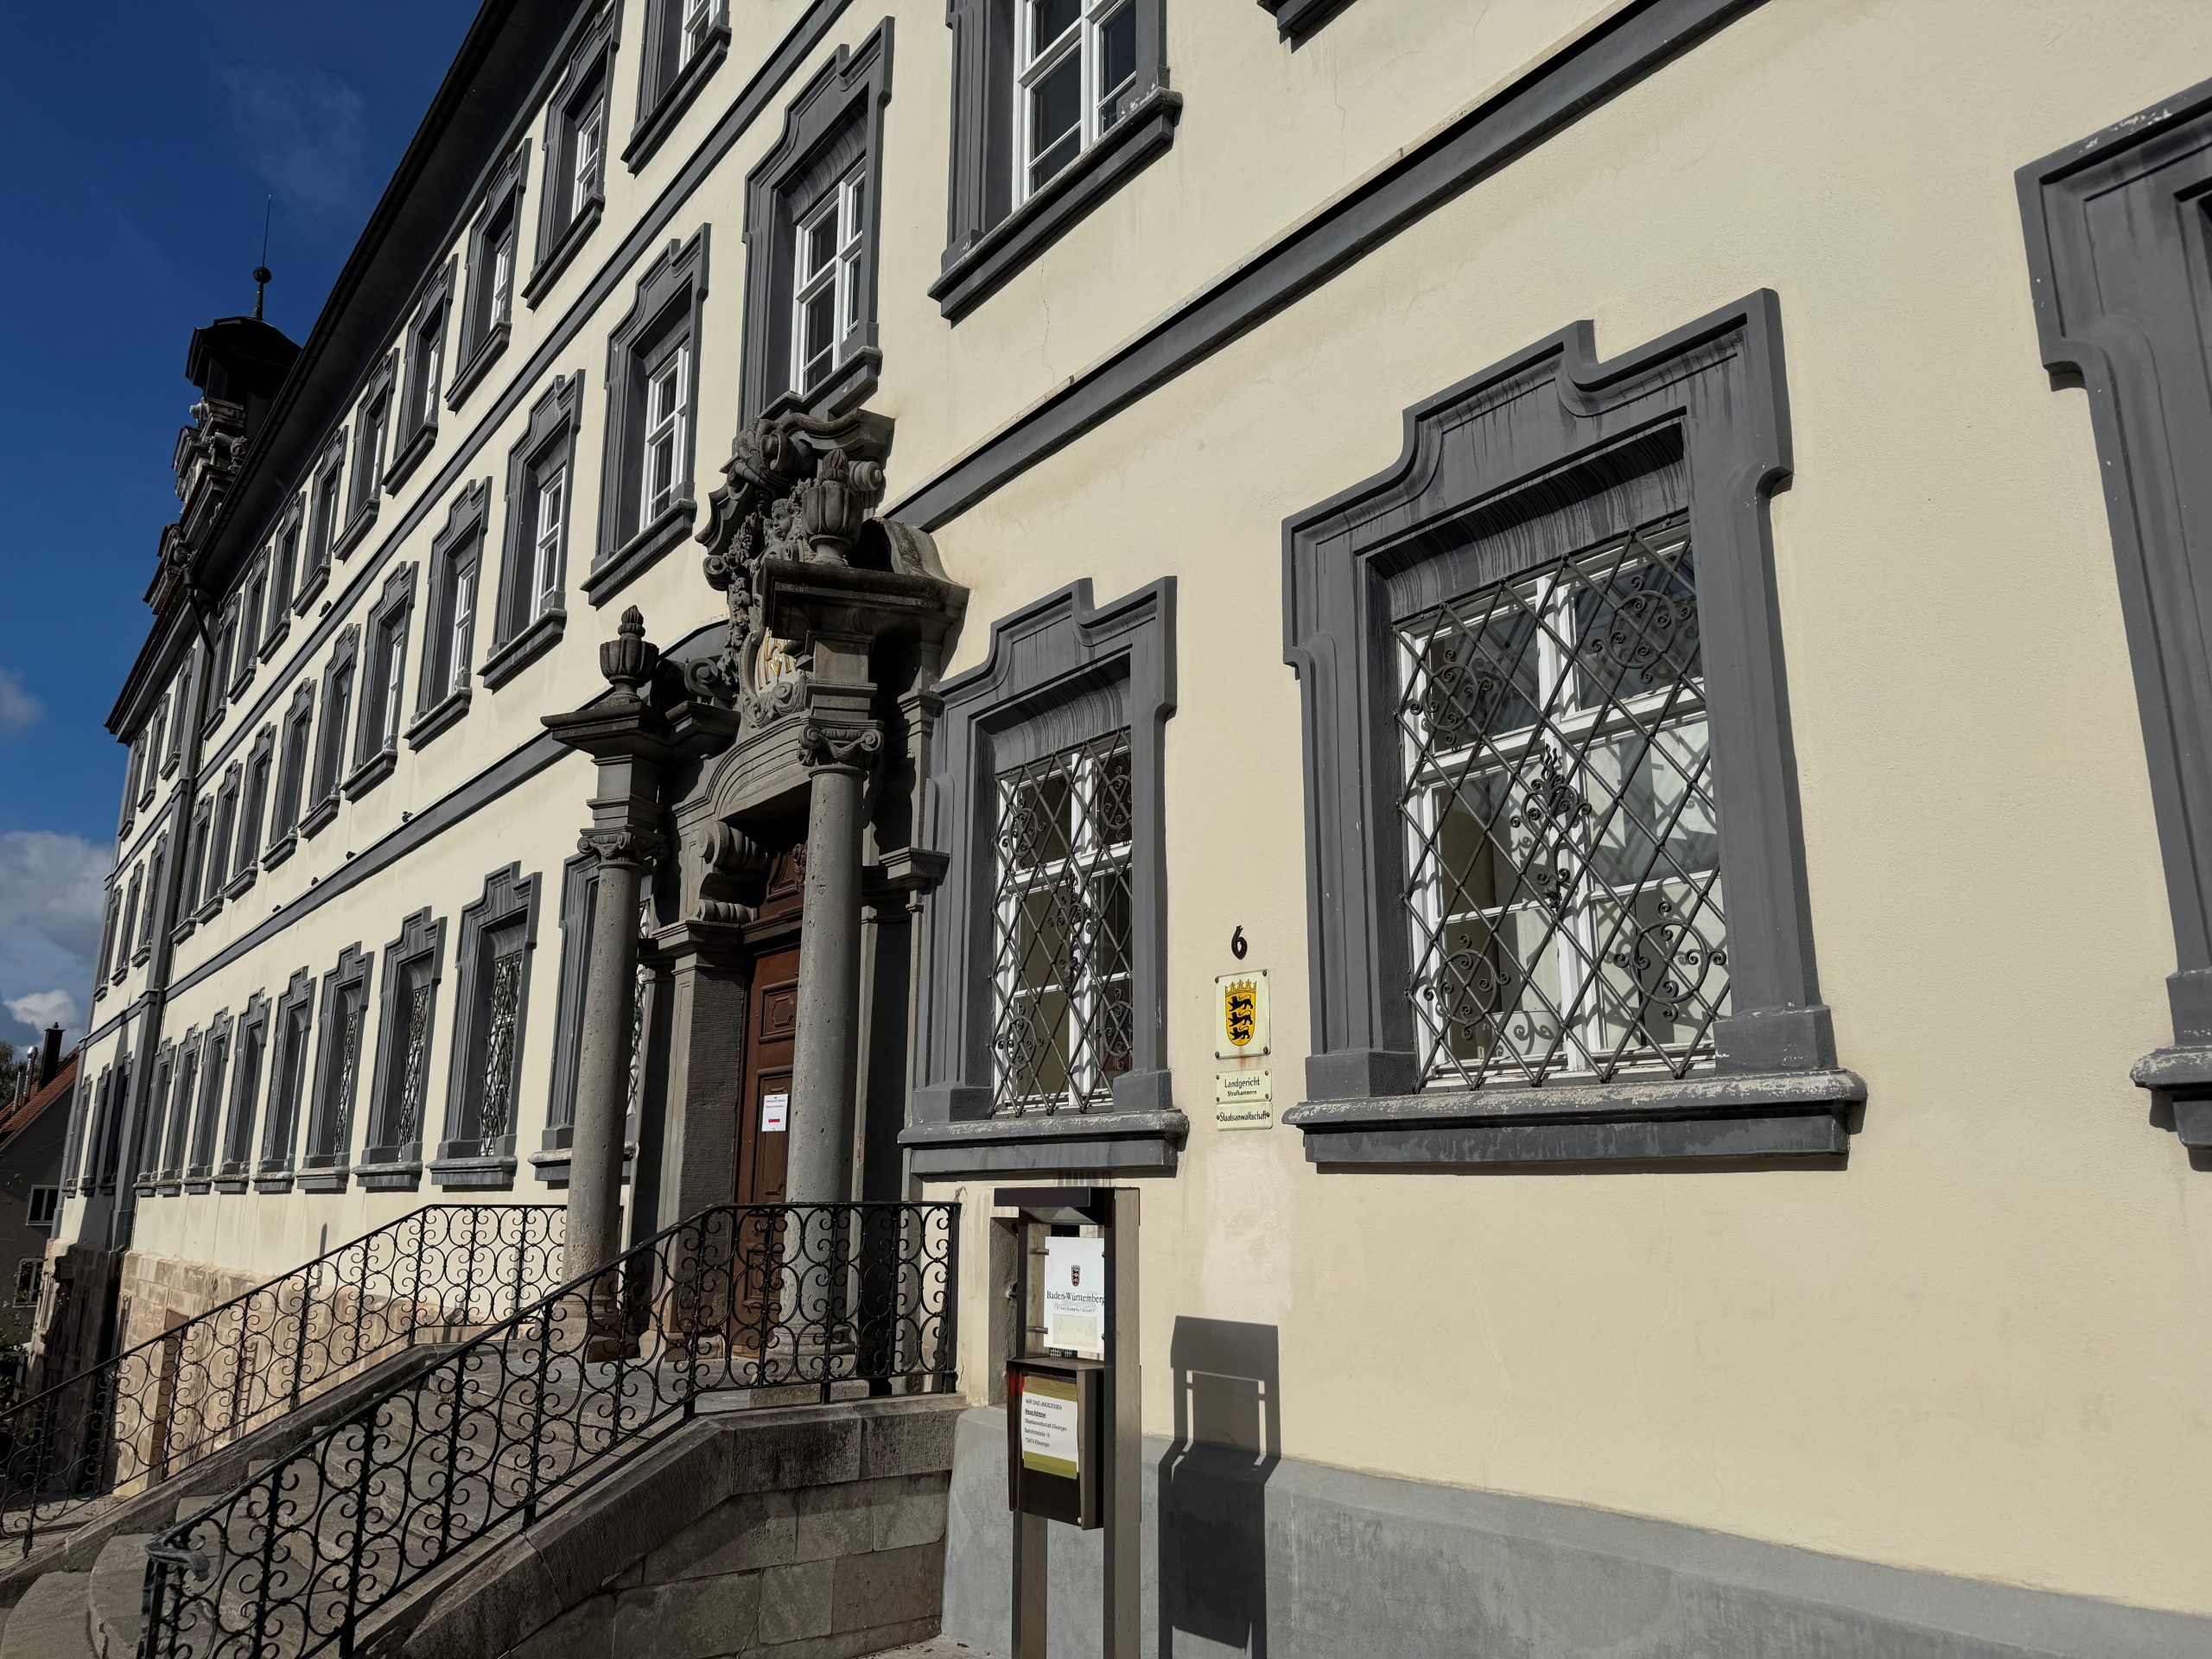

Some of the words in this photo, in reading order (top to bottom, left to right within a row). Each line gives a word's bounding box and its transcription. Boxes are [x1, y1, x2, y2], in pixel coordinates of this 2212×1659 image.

[1231, 925, 1248, 960] 6
[1224, 1076, 1260, 1089] Landgericht
[1219, 1110, 1268, 1122] Staatsanwaltschaft
[1046, 1290, 1105, 1306] Baden-Württemberg
